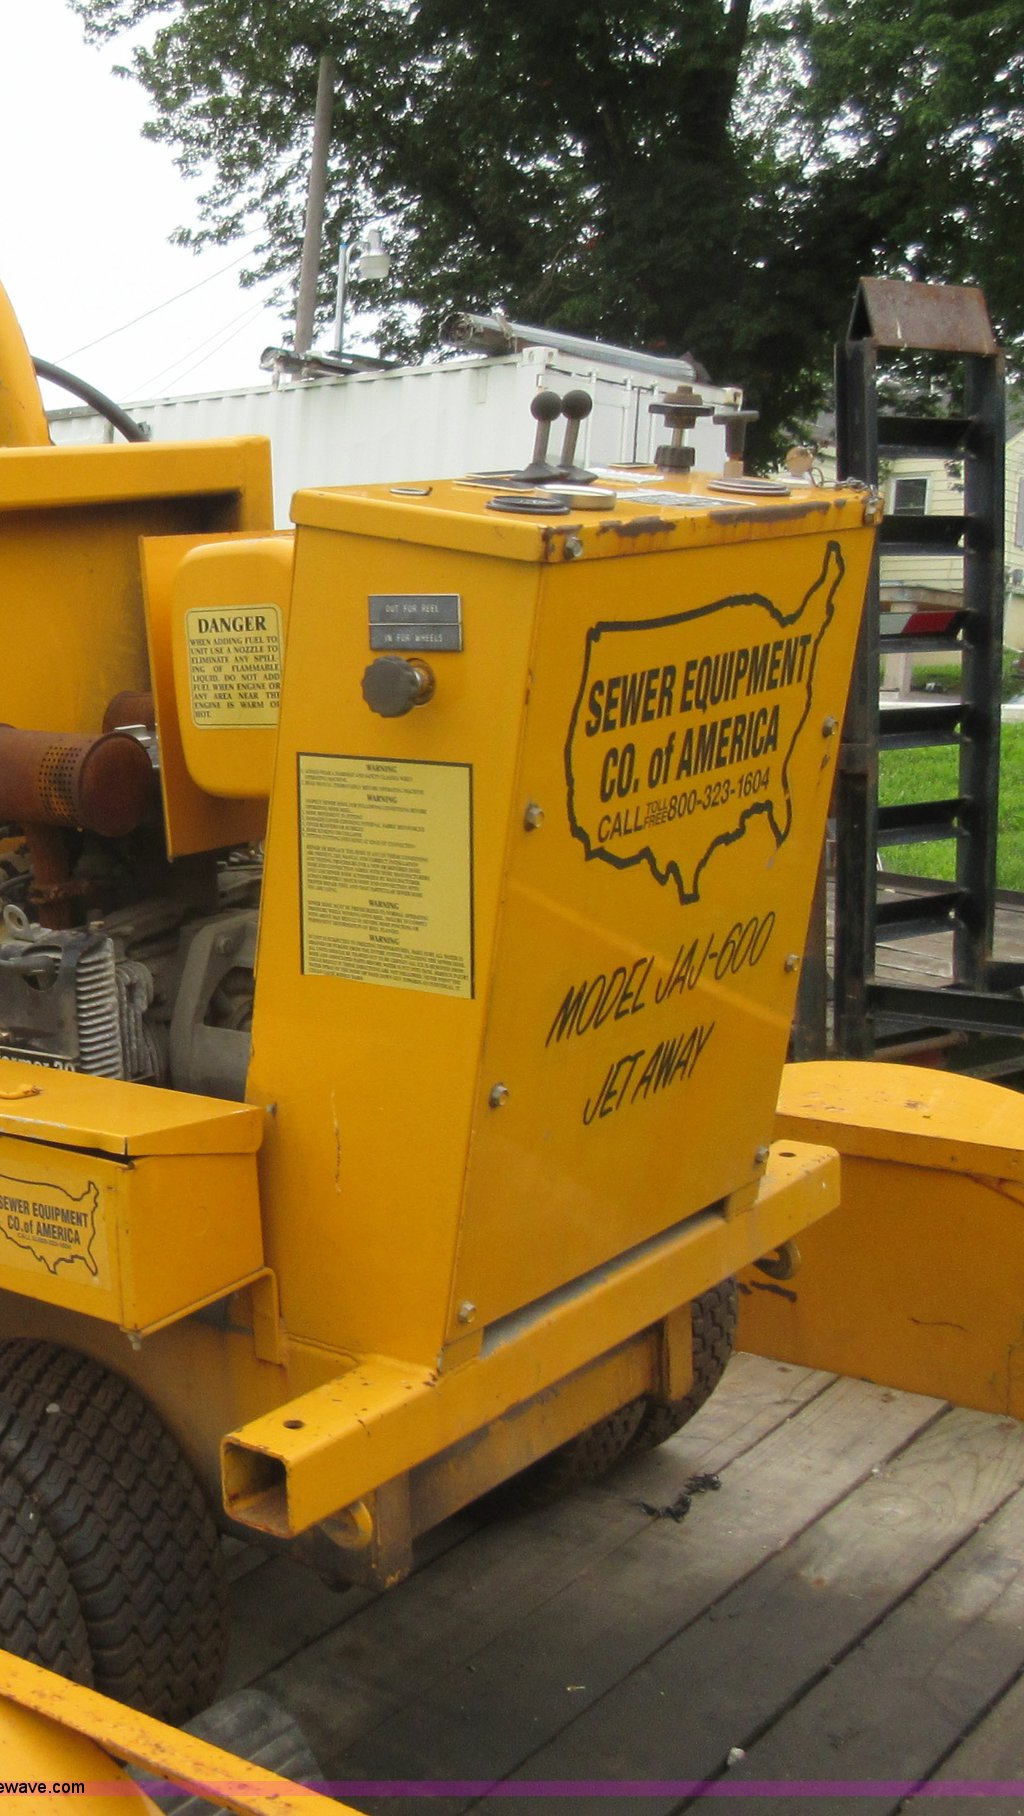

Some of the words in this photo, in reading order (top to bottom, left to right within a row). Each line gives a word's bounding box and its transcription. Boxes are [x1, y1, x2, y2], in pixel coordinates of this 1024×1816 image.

[198, 616, 266, 633] DANGER
[190, 638, 211, 646] WHEN
[213, 637, 243, 645] ADDING
[245, 636, 264, 645] FUEL
[267, 635, 278, 643] TO
[190, 647, 208, 655] UNIT
[210, 646, 223, 654] USE
[234, 645, 264, 654] NOZZLE
[267, 645, 279, 653] TO
[191, 656, 229, 664] ELIMINATE
[234, 655, 248, 663] ANY
[191, 665, 206, 673] ING
[213, 665, 223, 673] OF
[231, 663, 279, 672] FLAMMABLE
[241, 673, 257, 681] NOT
[263, 673, 280, 681] ADD
[193, 683, 210, 691] FUEL
[212, 683, 234, 691] WHEN
[268, 682, 280, 690] OR
[585, 664, 676, 737] SEWER
[679, 633, 812, 714] EQUIPMENT
[214, 692, 232, 700] AREA
[194, 701, 221, 709] ENGINE
[599, 743, 639, 803] CO.
[647, 730, 677, 789] of
[676, 704, 780, 781] AMERICA
[366, 764, 398, 773] WARNING
[366, 794, 398, 804] WARNING
[597, 805, 644, 844] CALL
[667, 766, 771, 821] 800-323-1604
[646, 799, 669, 815] TOLL
[644, 811, 668, 829] FREE
[368, 899, 400, 910] WARNING
[369, 934, 400, 945] WARNING
[545, 956, 656, 1048] MODEL
[583, 1050, 646, 1125] JET
[631, 1021, 716, 1104] AWAY
[32, 1202, 89, 1228] EQUIPMENT
[24, 1220, 34, 1234] of
[36, 1221, 81, 1245] AMERICA
